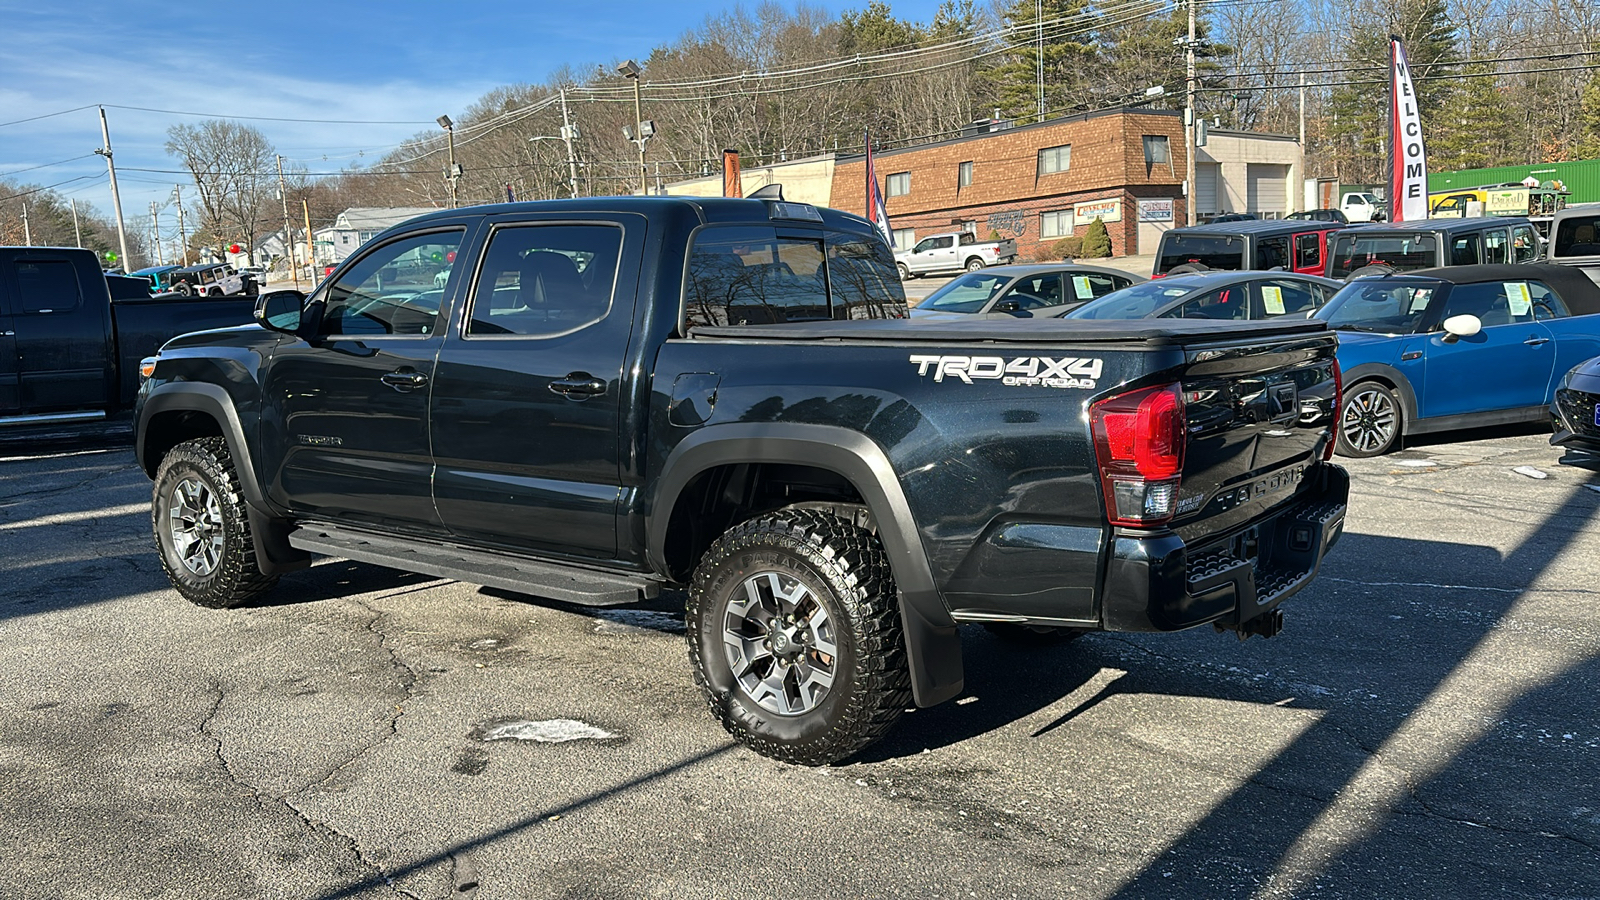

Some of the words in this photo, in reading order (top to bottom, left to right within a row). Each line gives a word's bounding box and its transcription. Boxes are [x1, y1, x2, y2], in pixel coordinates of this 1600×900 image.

[1397, 63, 1422, 198] WELCOME
[1077, 203, 1116, 216] CONSUMER
[910, 354, 1005, 385] TRD
[1002, 376, 1040, 387] OFF
[1041, 377, 1097, 390] ROAD
